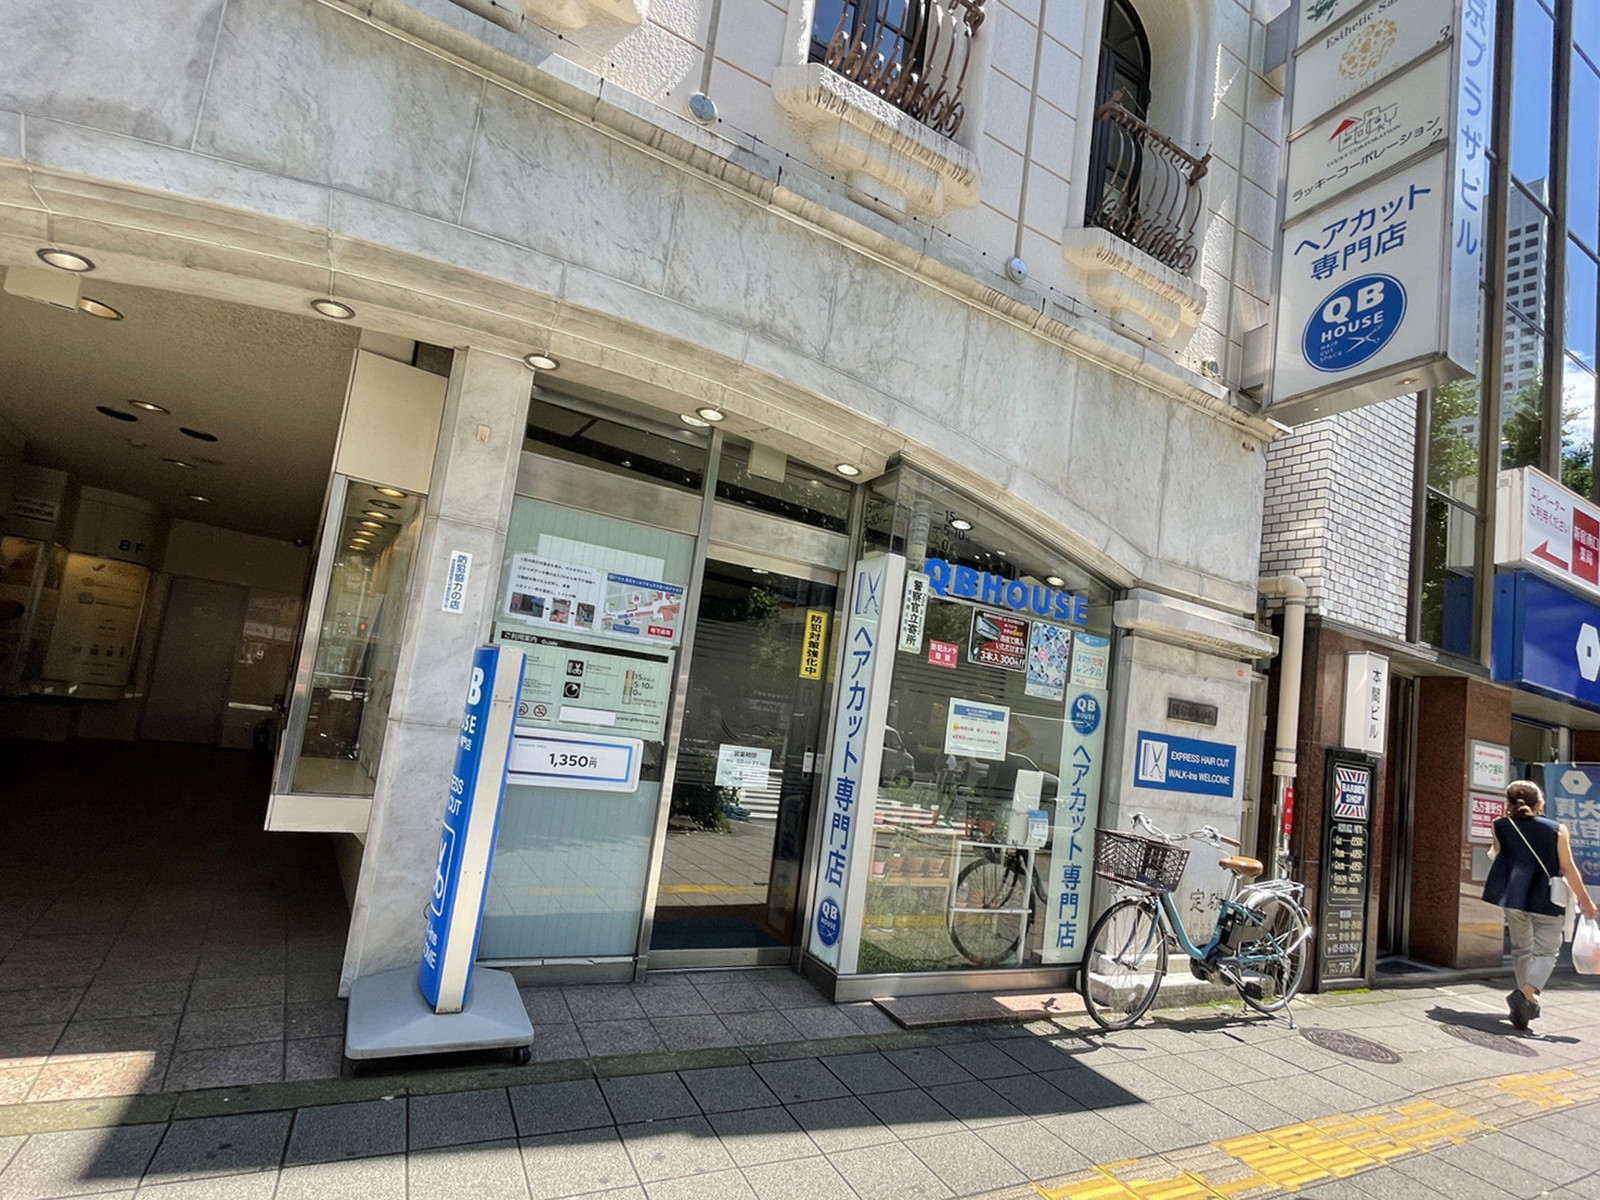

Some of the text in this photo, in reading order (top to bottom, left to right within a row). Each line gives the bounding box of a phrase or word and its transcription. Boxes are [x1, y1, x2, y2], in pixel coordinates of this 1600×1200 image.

[1326, 12, 1374, 49] Esthetic
[1292, 116, 1440, 202] ラッキーコーポレーション
[1294, 184, 1432, 256] ヘアカット
[1310, 220, 1408, 280] 専門店
[1322, 281, 1385, 325] QB
[1321, 310, 1385, 343] HOUSE
[906, 580, 923, 646] 警察官立寄所
[805, 614, 822, 675] 防犯対策強化中
[1076, 712, 1095, 721] HOUSE
[1077, 699, 1096, 712] QB
[825, 626, 874, 888] ヘアカット専門店
[1171, 750, 1230, 768] EXPRESS HAIR CUT
[1168, 768, 1230, 786] WALK-Ins WELCOME
[1341, 782, 1366, 795] BARBER
[1345, 794, 1362, 805] SHOP
[1056, 744, 1092, 949] ヘアカット専門店
[822, 901, 838, 918] QB
